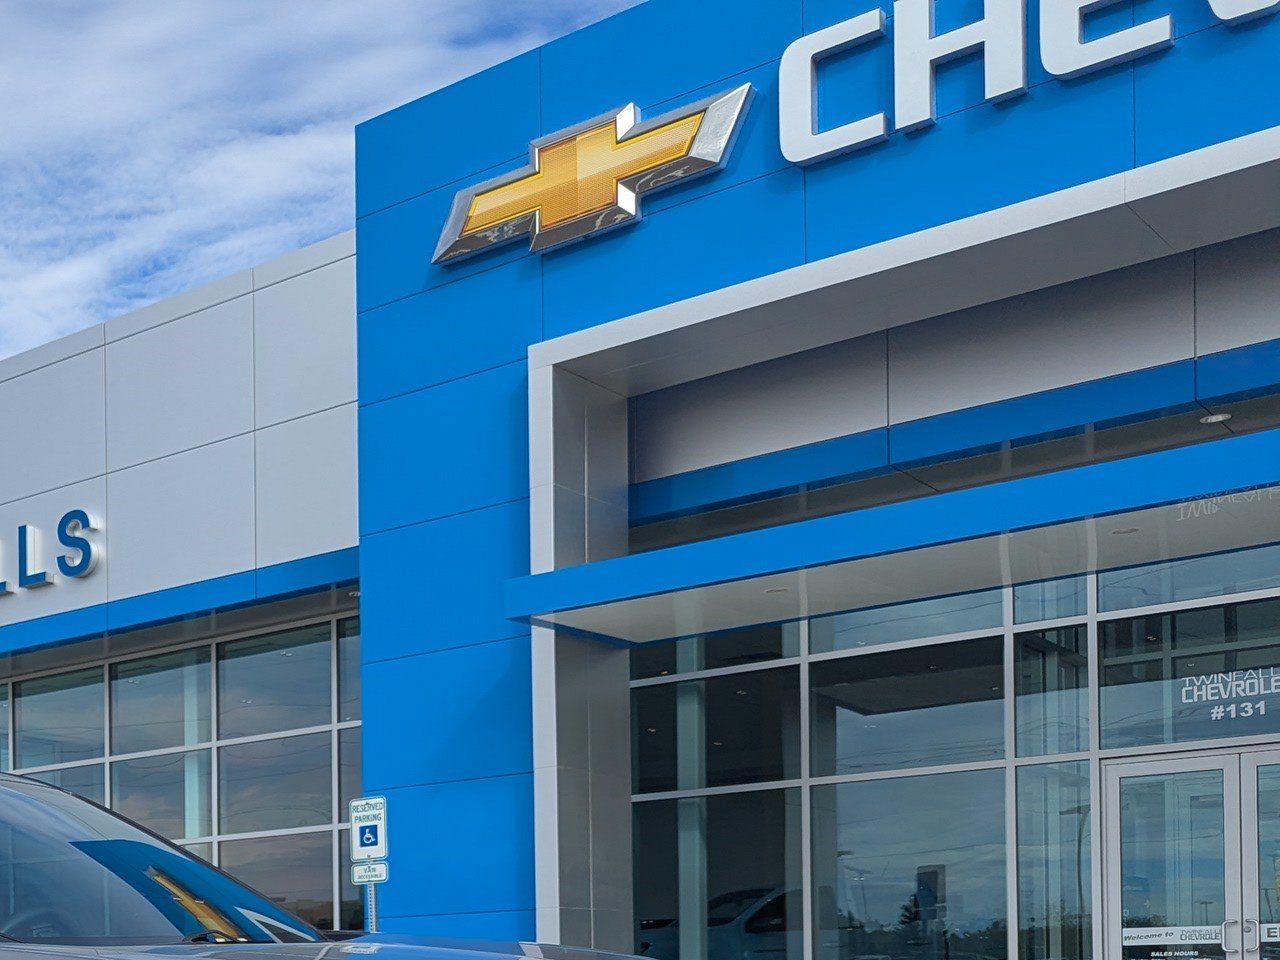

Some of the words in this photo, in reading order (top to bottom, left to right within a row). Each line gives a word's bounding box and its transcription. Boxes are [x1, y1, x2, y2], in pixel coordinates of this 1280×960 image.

[779, 0, 1280, 166] CHE
[1210, 701, 1266, 721] #131
[352, 802, 383, 813] RESERVED
[354, 813, 382, 823] PARKING
[363, 866, 376, 874] VAN
[1124, 933, 1163, 941] Welcome
[1180, 932, 1222, 941] CHEVROLE
[1266, 927, 1280, 939] E
